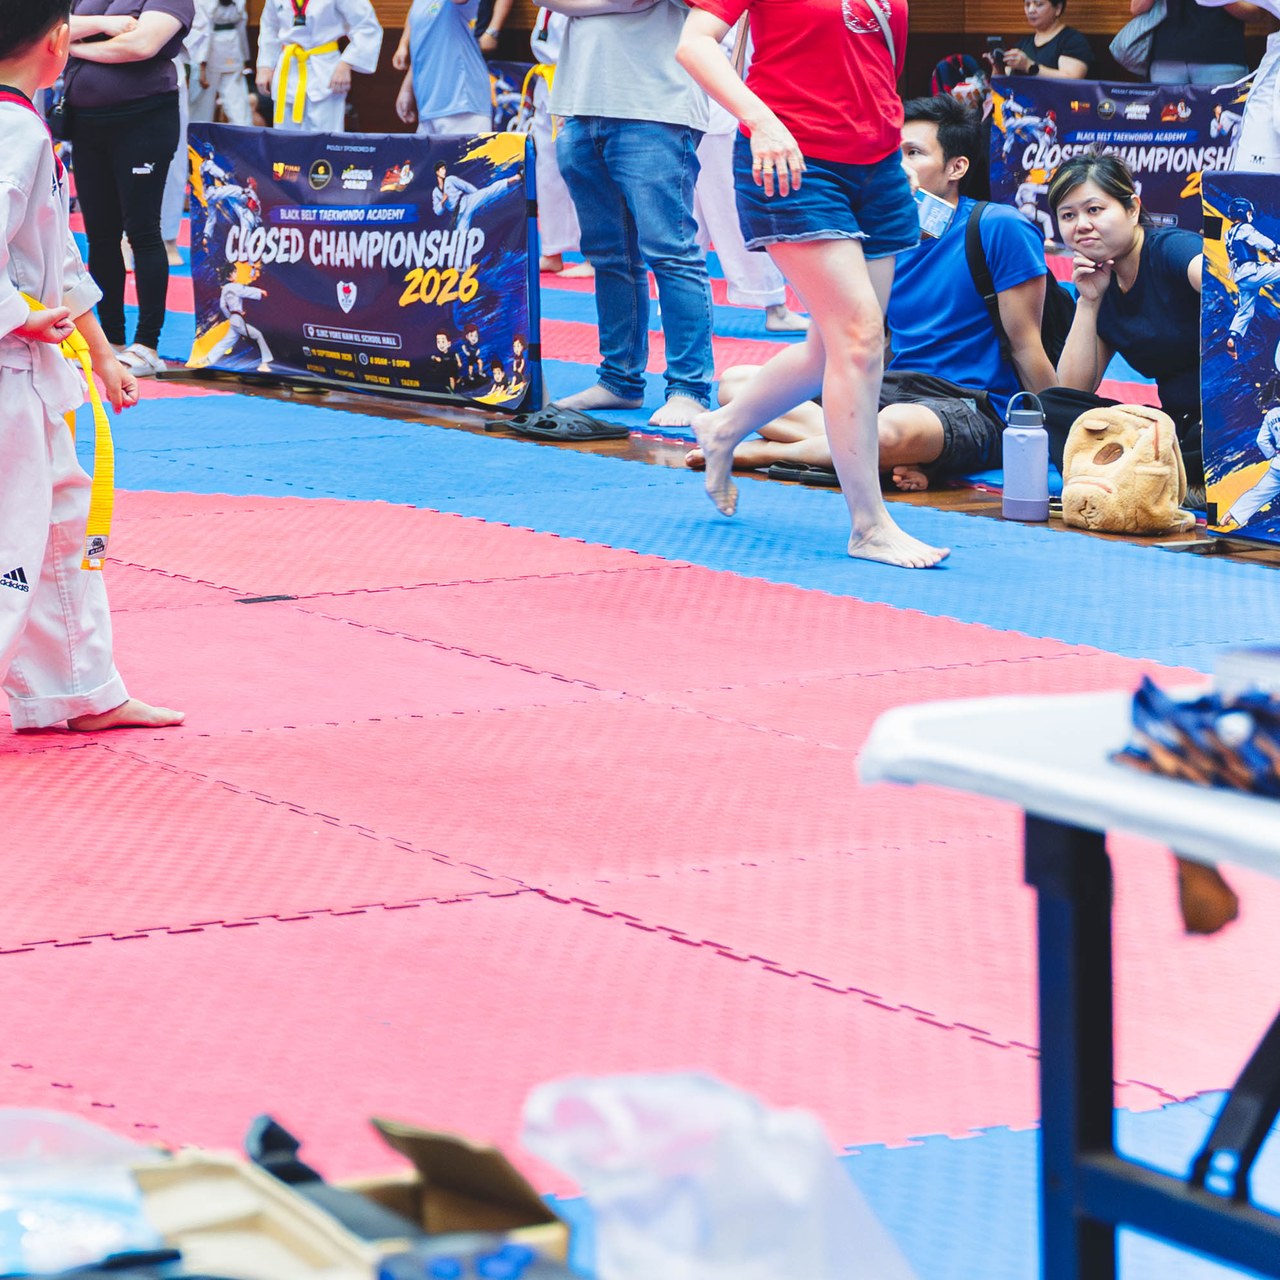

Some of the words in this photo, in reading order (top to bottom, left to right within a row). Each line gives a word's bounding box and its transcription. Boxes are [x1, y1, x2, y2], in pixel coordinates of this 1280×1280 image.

[1076, 131, 1095, 141] BLACK
[1096, 131, 1112, 142] BELT
[1113, 131, 1153, 142] TAEKWONDO
[1154, 131, 1187, 142] ACADEMY
[280, 208, 300, 220] BLACK
[301, 209, 317, 221] BELT
[319, 209, 365, 221] TAEKWONDO
[366, 209, 405, 220] ACADEMY
[225, 224, 305, 264] CLOSED
[309, 227, 486, 272] CHAMPIONSHIP
[398, 264, 481, 307] 2026
[0, 579, 30, 592] adidas
